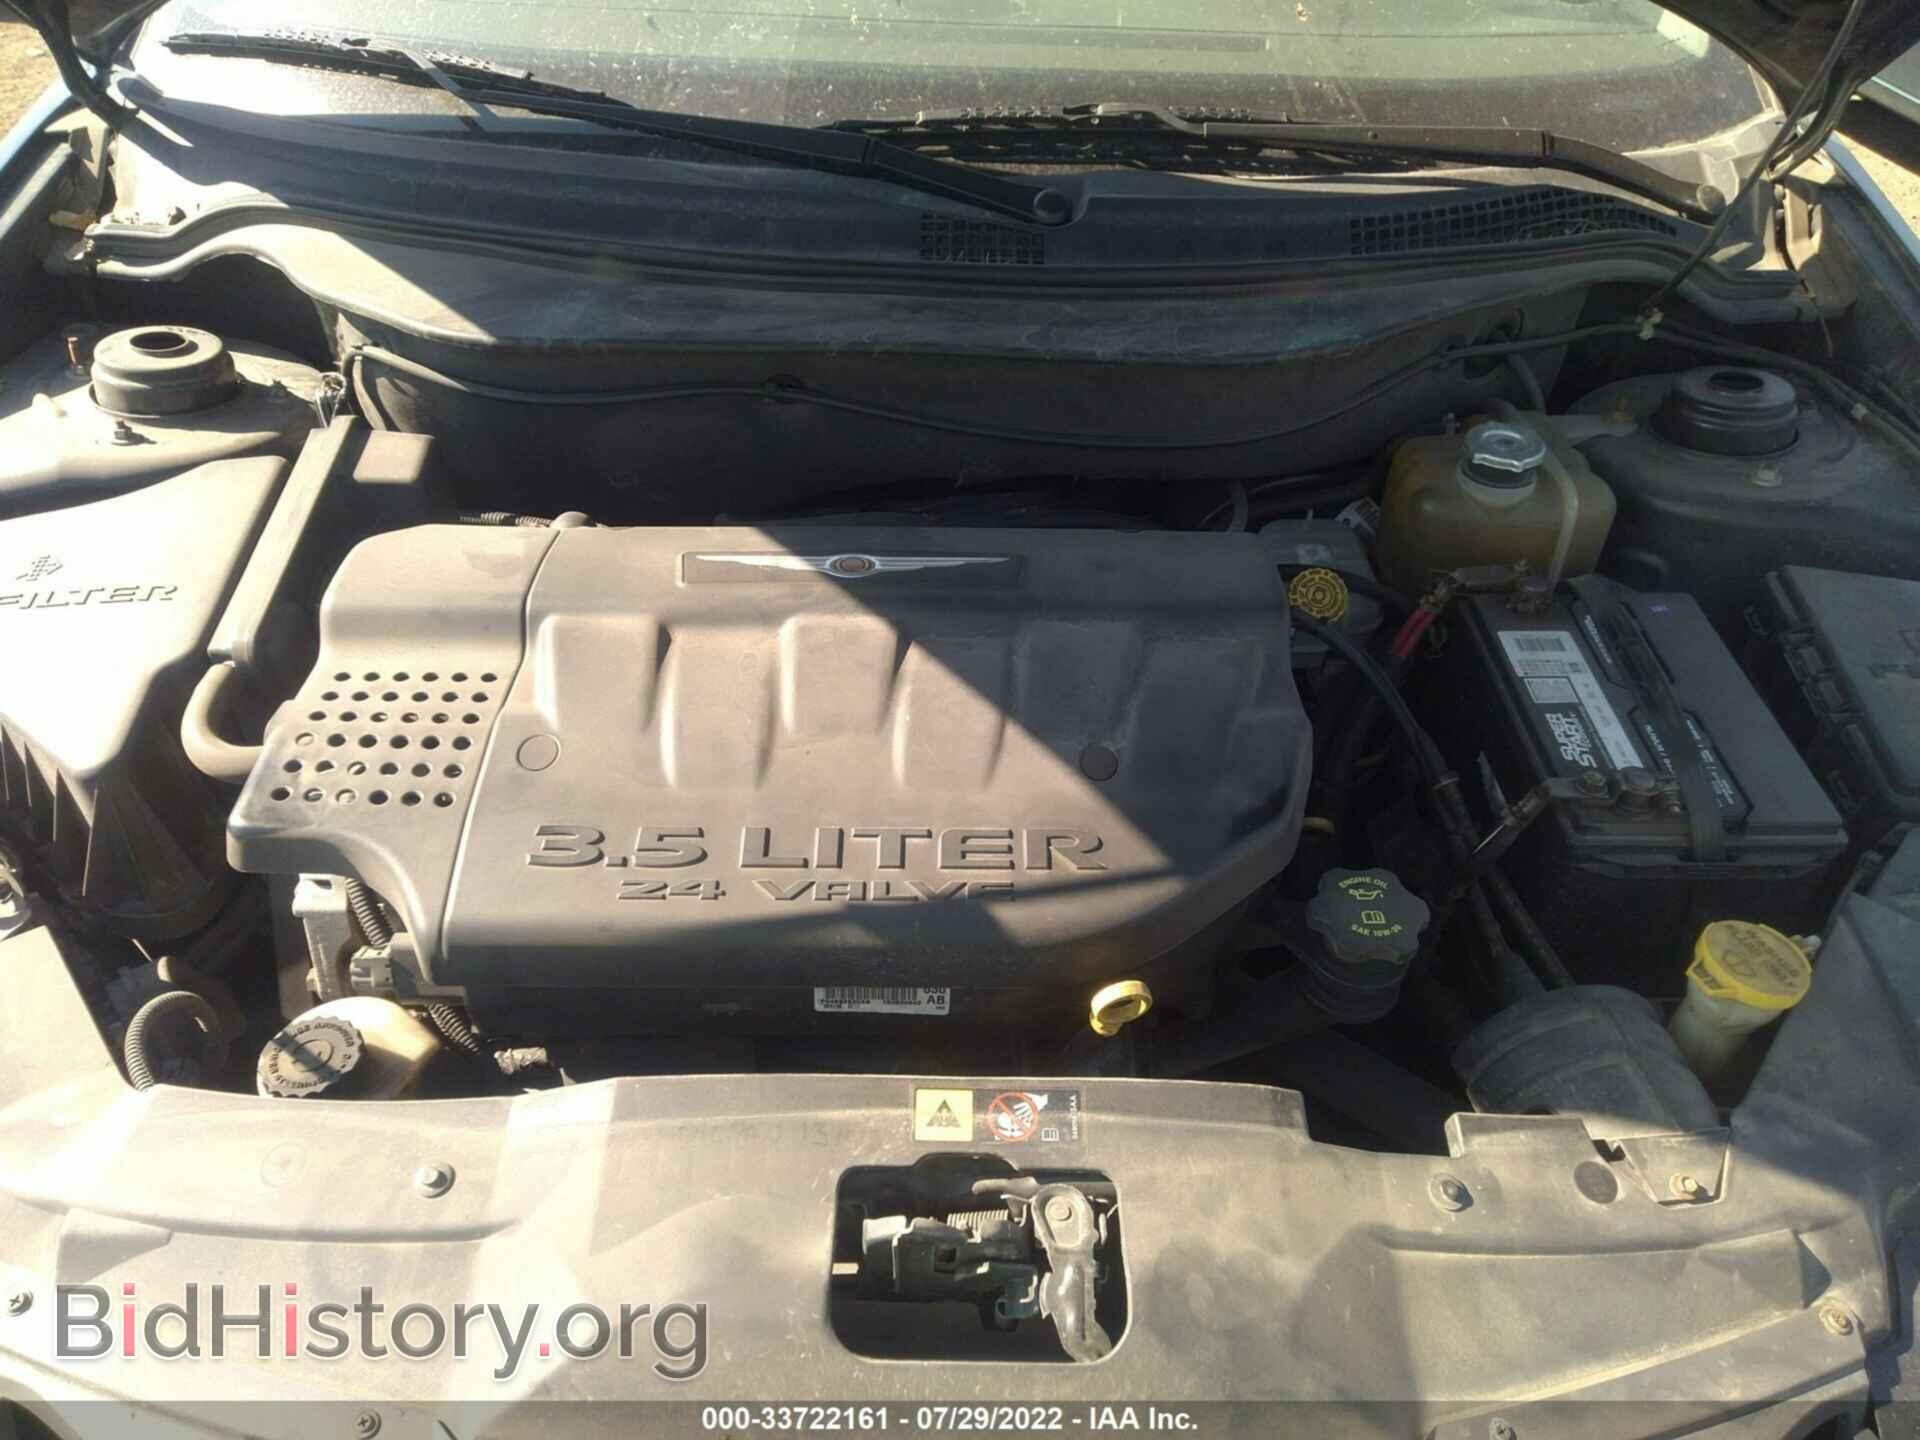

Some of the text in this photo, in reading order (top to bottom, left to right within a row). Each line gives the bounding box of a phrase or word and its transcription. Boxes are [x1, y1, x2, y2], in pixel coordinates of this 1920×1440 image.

[0, 585, 178, 609] FILTER
[1545, 713, 1574, 761] SUPER
[1563, 716, 1598, 768] START
[526, 824, 1107, 870] 3.5 LITER
[617, 880, 1014, 902] 24 VALVE
[926, 995, 945, 1005] AB
